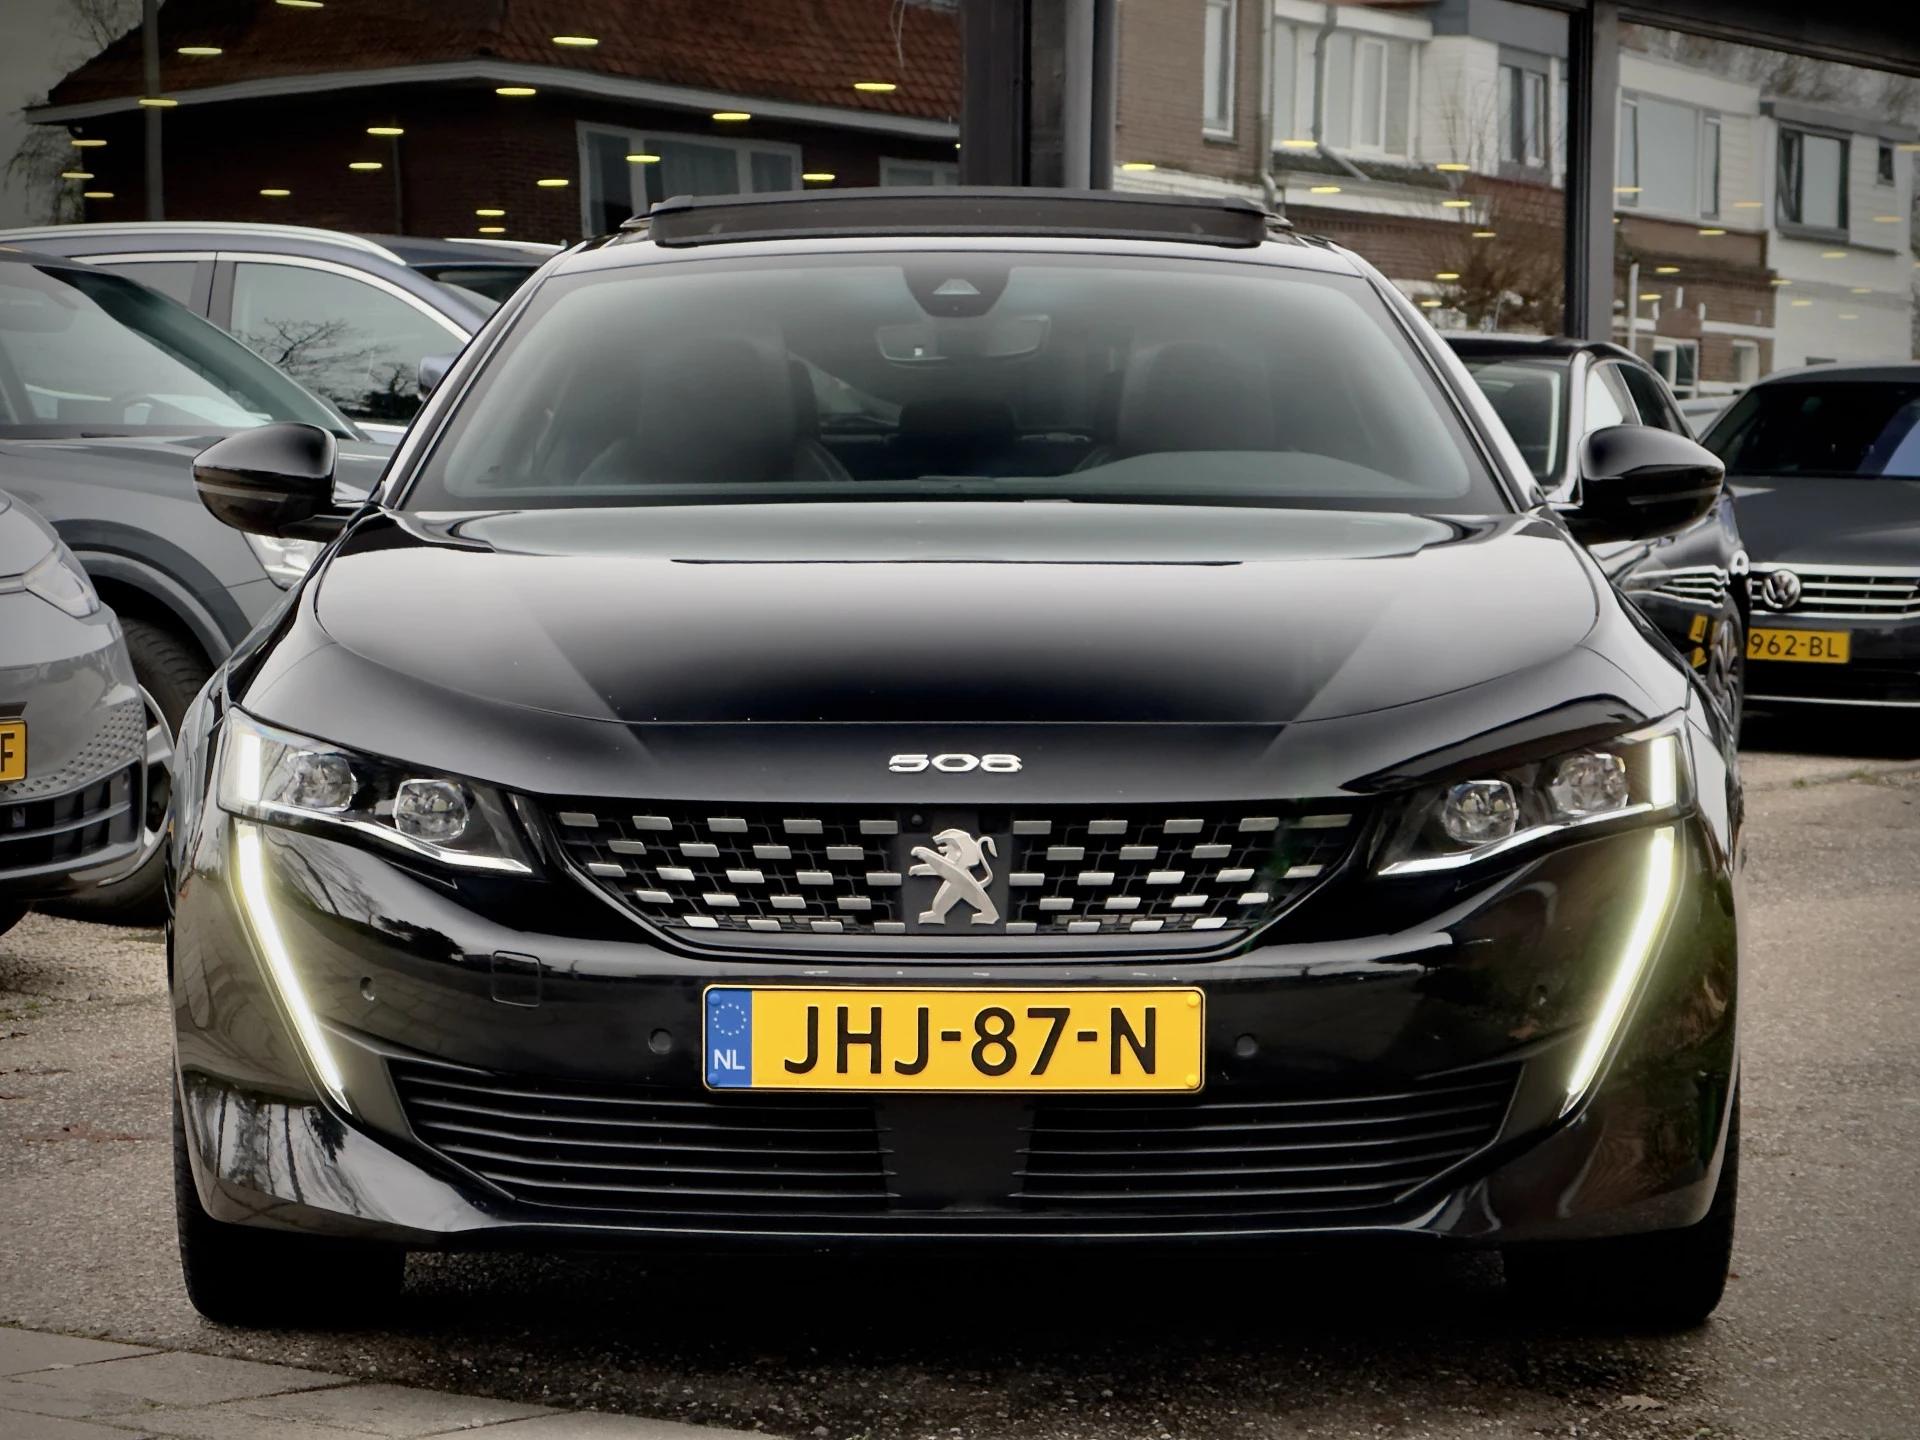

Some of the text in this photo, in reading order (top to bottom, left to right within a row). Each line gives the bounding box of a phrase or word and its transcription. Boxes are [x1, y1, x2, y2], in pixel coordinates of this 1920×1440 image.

[1750, 633, 1839, 658] 962-BL
[1, 732, 15, 772] F
[888, 753, 1023, 773] 508
[784, 1006, 1156, 1077] JHJ-87-N
[714, 1049, 746, 1070] NL
